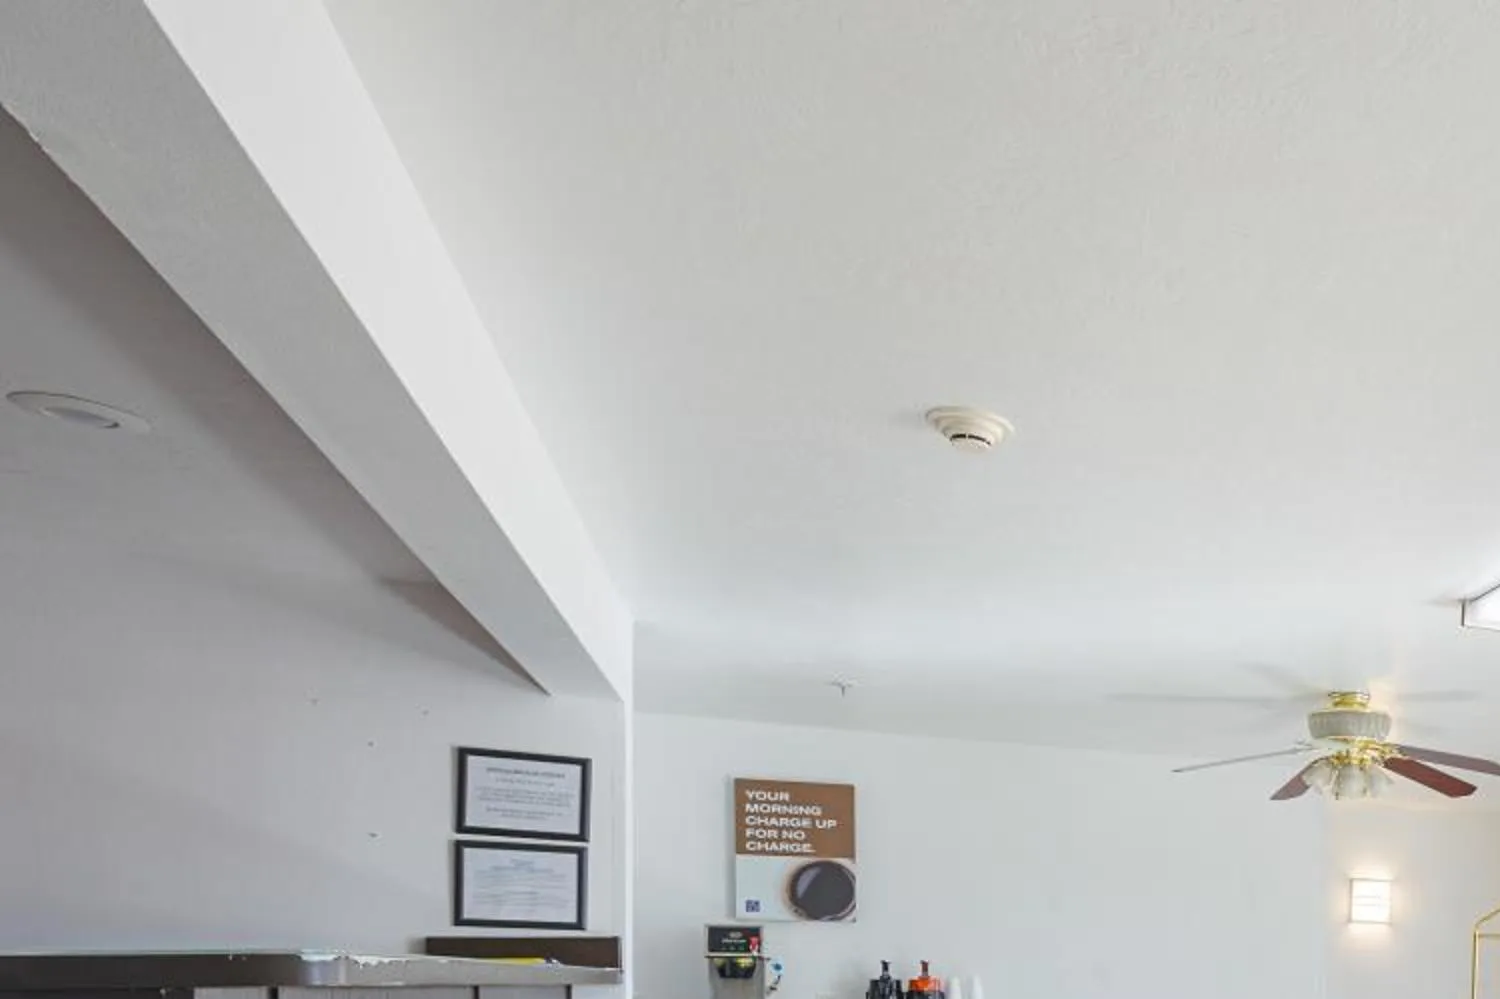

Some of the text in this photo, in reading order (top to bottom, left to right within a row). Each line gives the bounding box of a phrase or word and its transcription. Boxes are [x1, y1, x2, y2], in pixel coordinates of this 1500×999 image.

[746, 791, 789, 801] YOUR
[746, 804, 822, 815] MORNING
[745, 815, 837, 829] CHARGE UP
[745, 829, 806, 841] FOR NO
